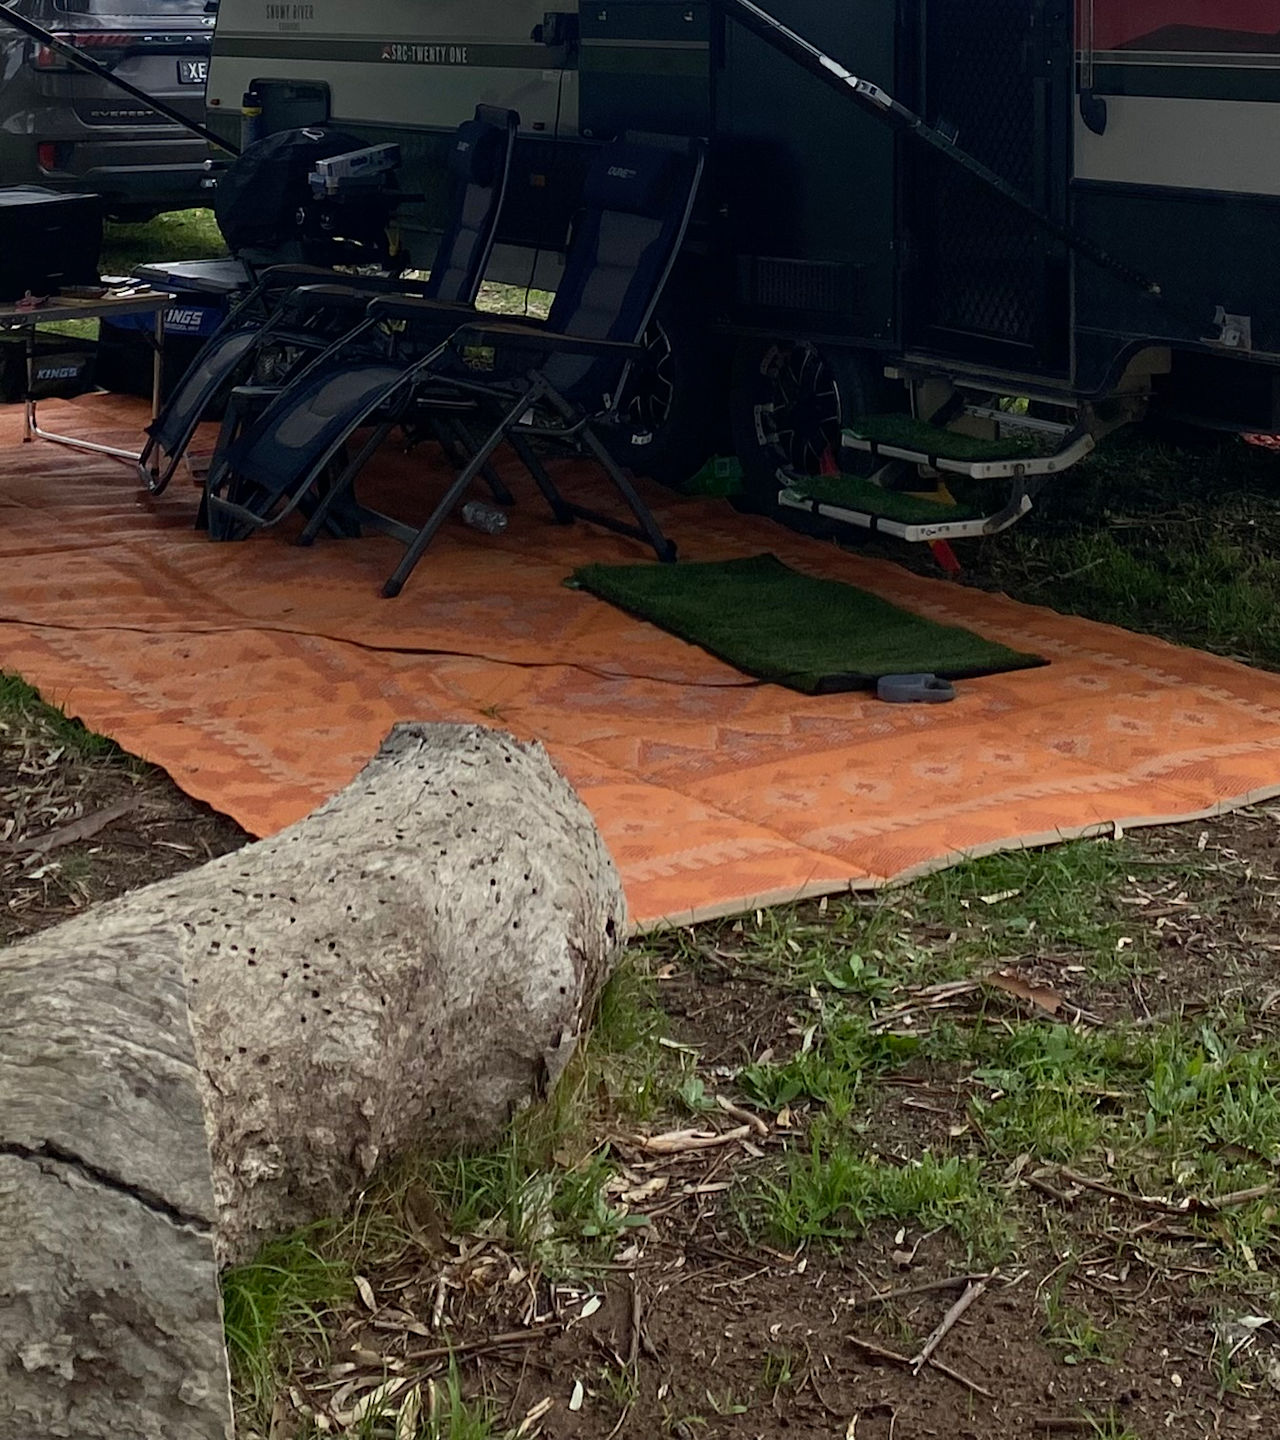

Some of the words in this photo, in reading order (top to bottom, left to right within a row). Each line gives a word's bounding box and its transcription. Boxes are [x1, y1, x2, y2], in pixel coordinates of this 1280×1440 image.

[391, 44, 446, 62] SRC-TWENTY
[450, 47, 468, 63] ONE
[37, 367, 78, 379] KINGS
